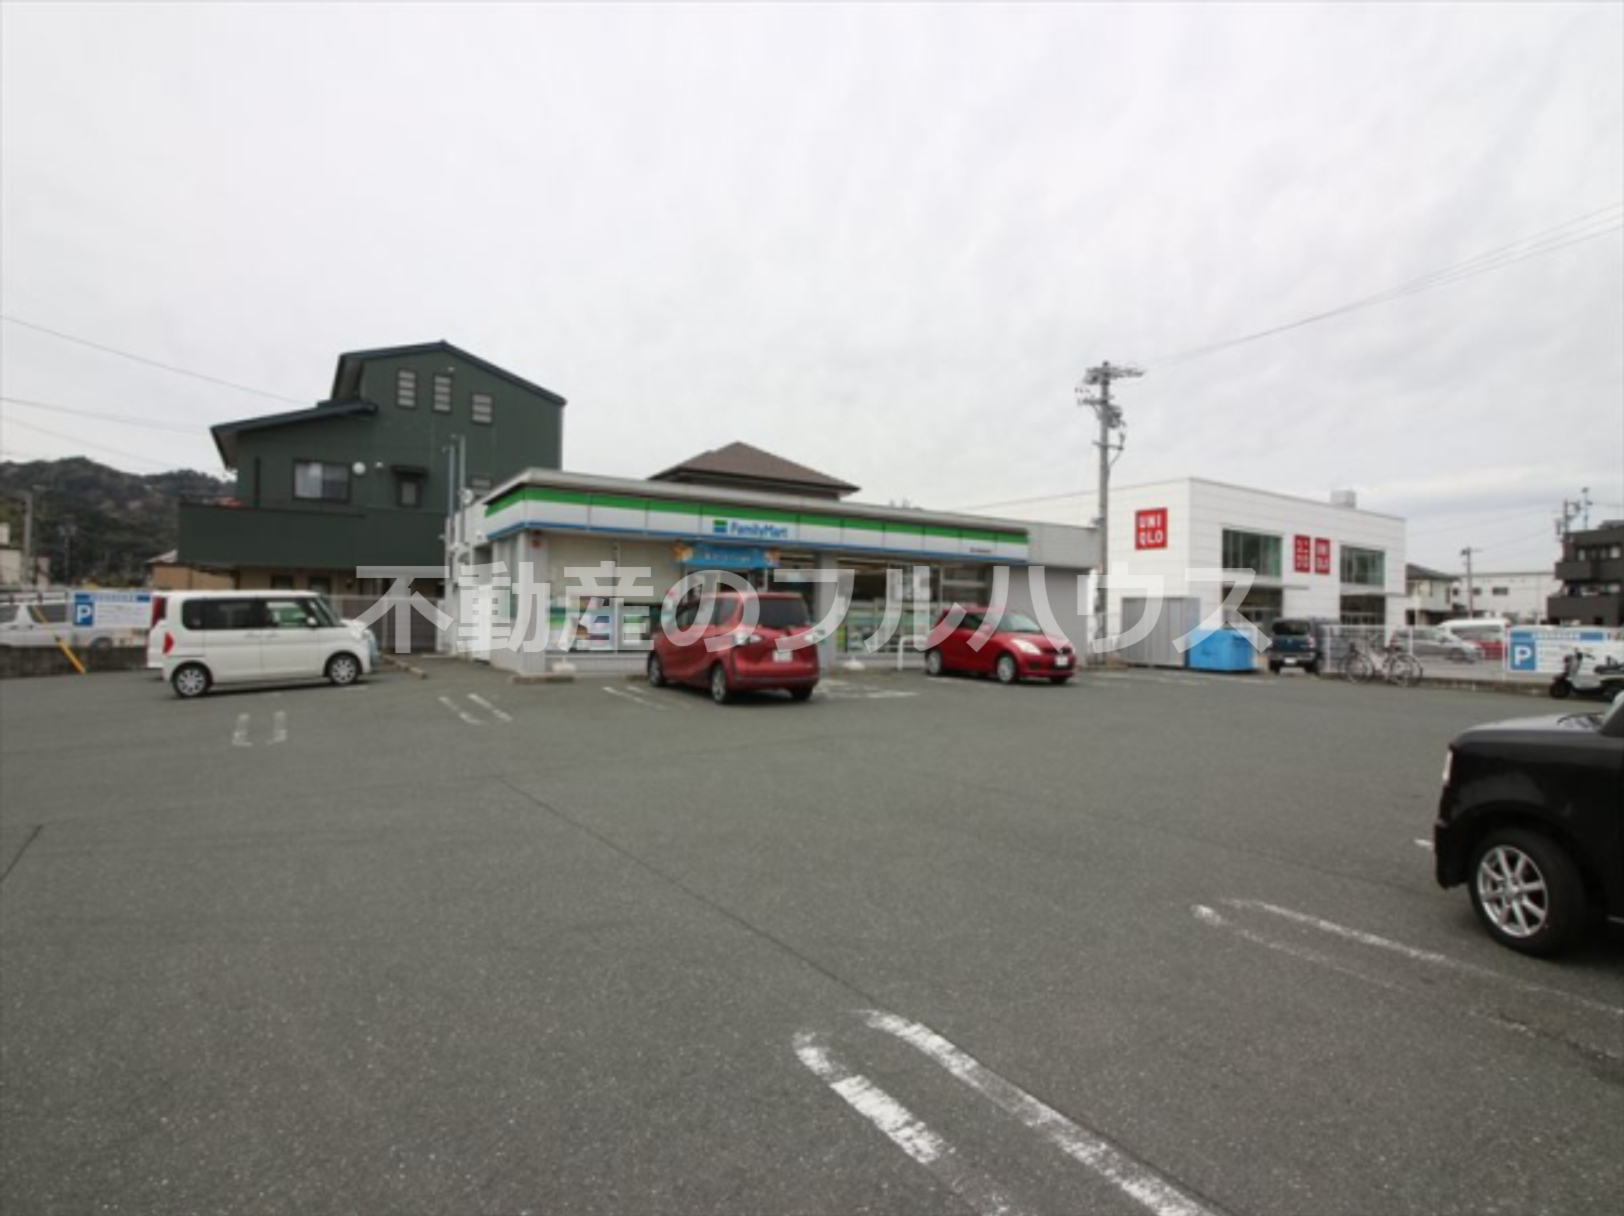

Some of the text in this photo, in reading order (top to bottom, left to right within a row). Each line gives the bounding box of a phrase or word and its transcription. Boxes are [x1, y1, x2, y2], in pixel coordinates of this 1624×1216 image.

[731, 521, 788, 539] FamilyMart
[1139, 514, 1161, 528] UNI
[1139, 530, 1163, 546] QLO
[77, 604, 92, 624] P
[1514, 645, 1532, 667] P
